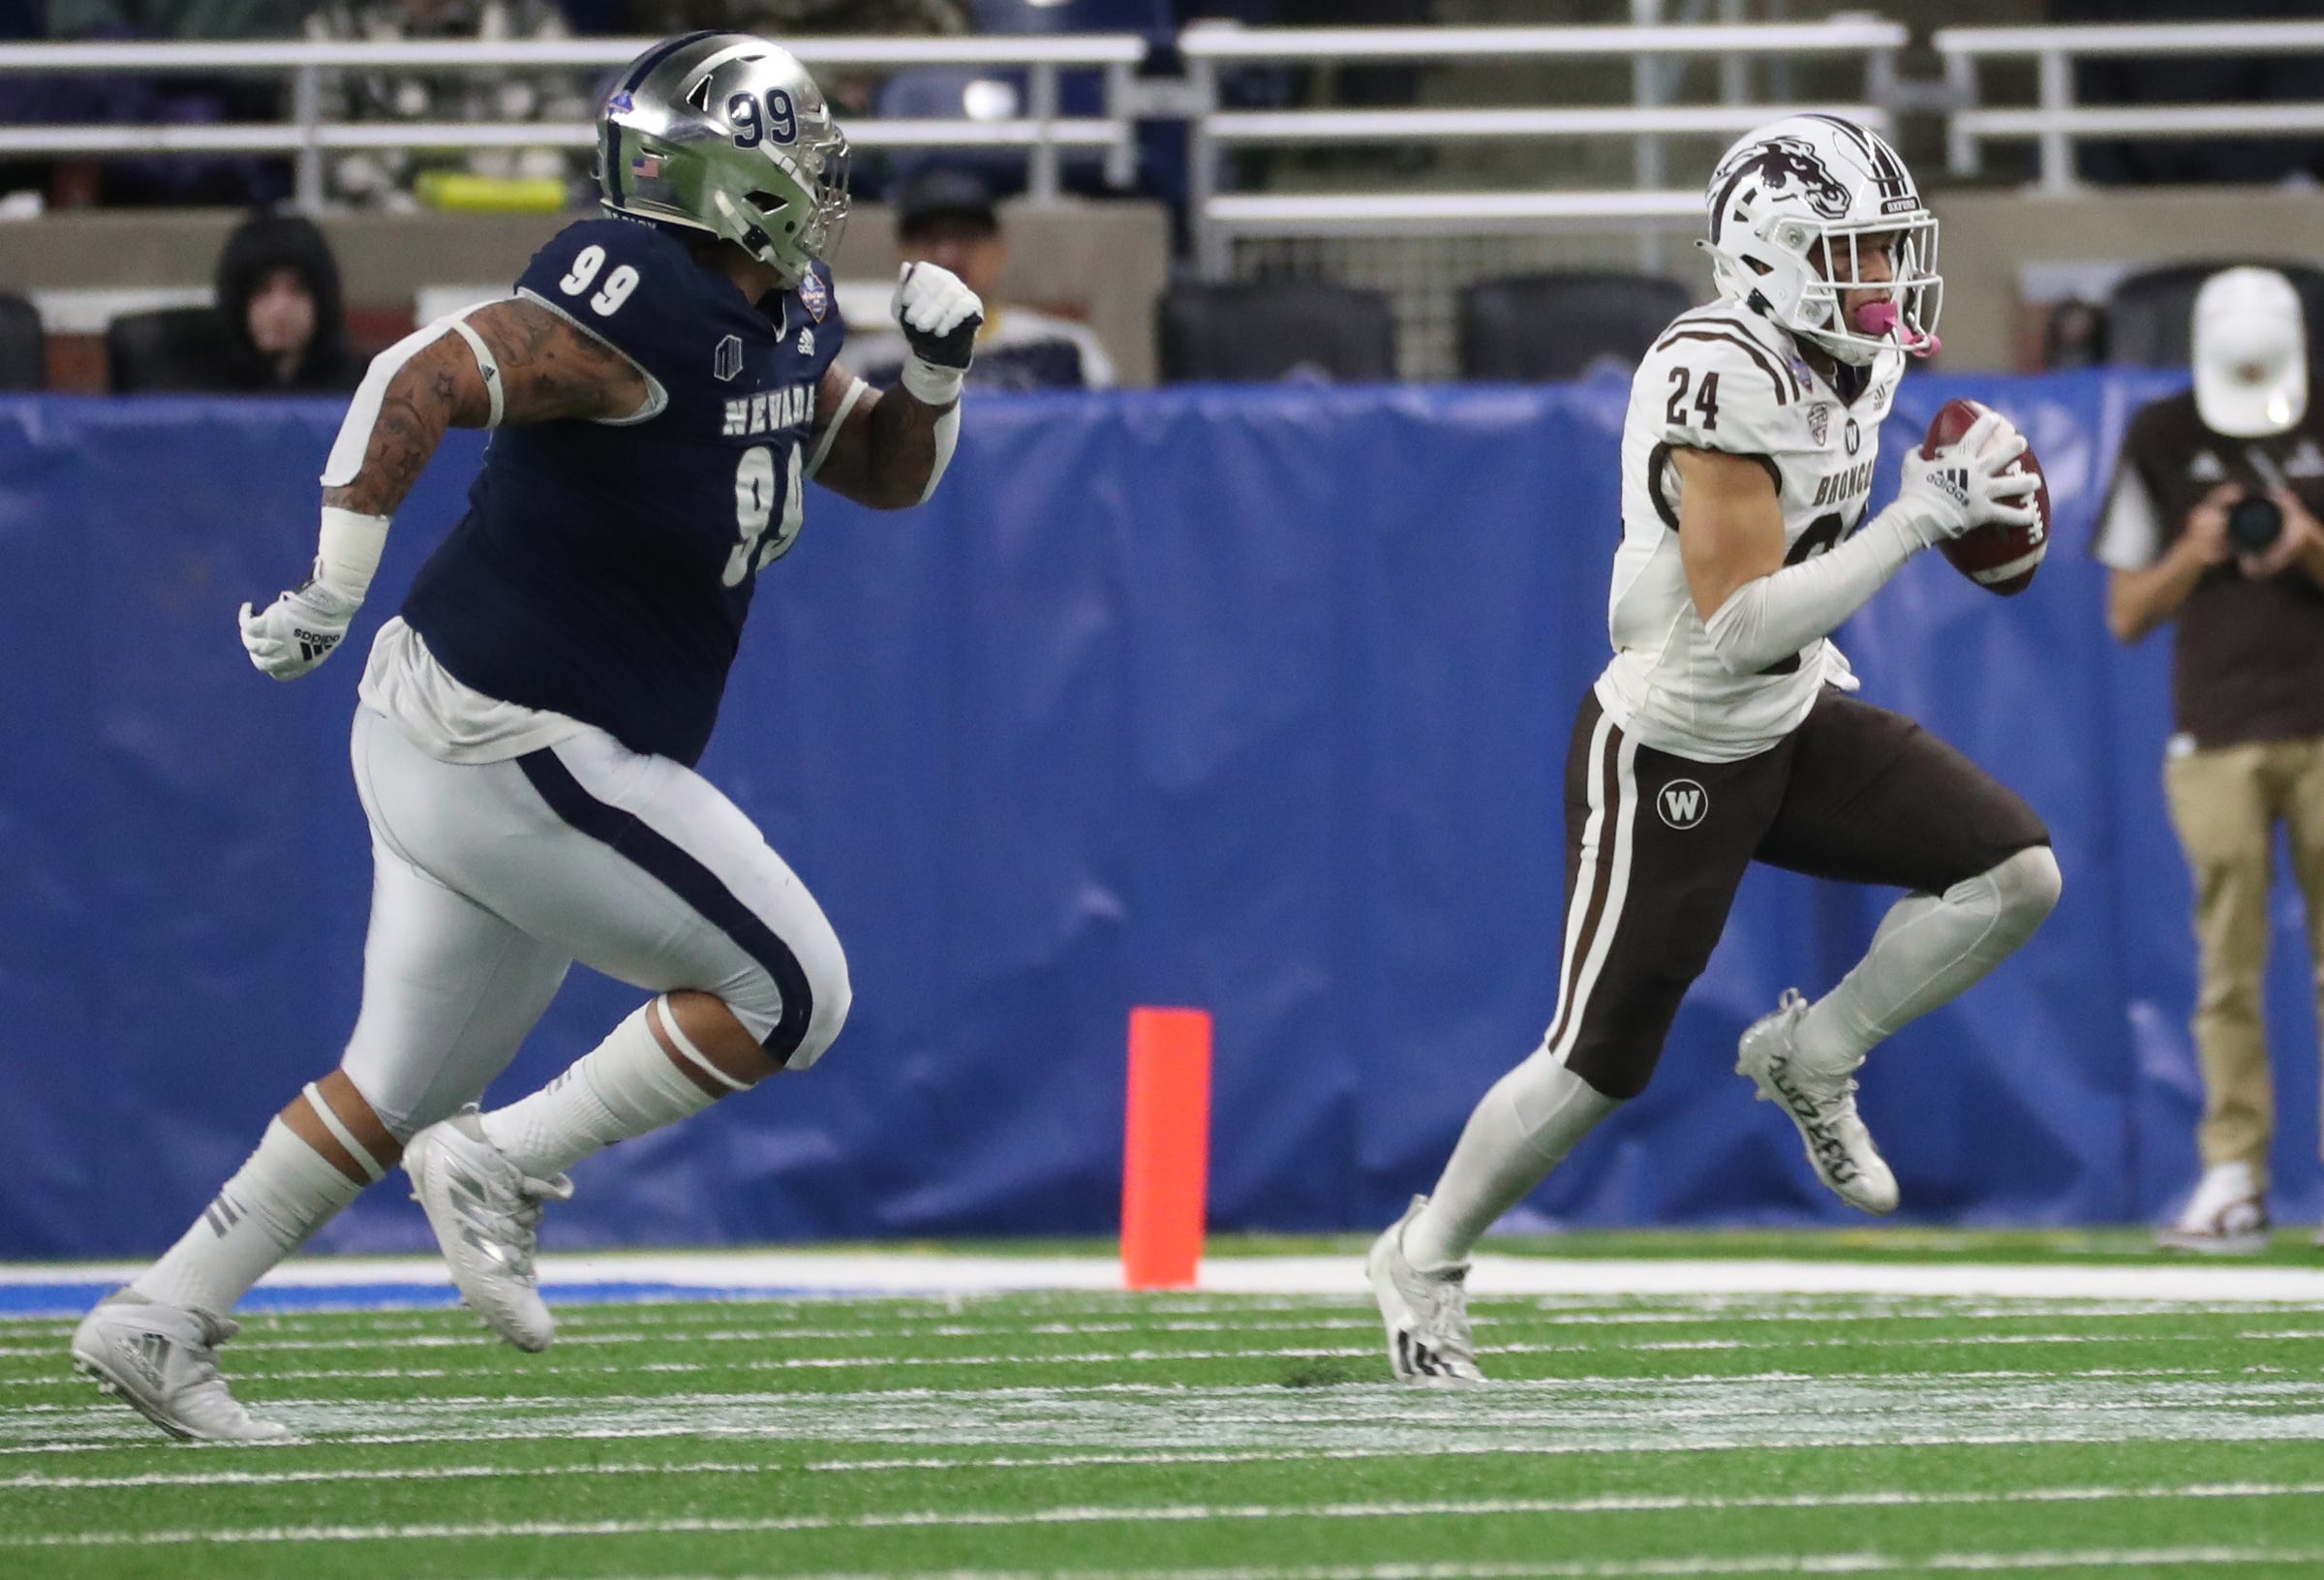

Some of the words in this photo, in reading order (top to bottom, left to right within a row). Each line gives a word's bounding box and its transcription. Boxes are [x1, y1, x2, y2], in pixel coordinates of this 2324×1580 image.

[724, 87, 798, 149] 99
[560, 244, 639, 317] 99
[1667, 367, 1719, 430] 24
[1846, 424, 1857, 452] W
[1926, 473, 1970, 506] adidas
[722, 441, 804, 588] 99
[293, 627, 341, 644] adidas
[1666, 790, 1699, 821] W
